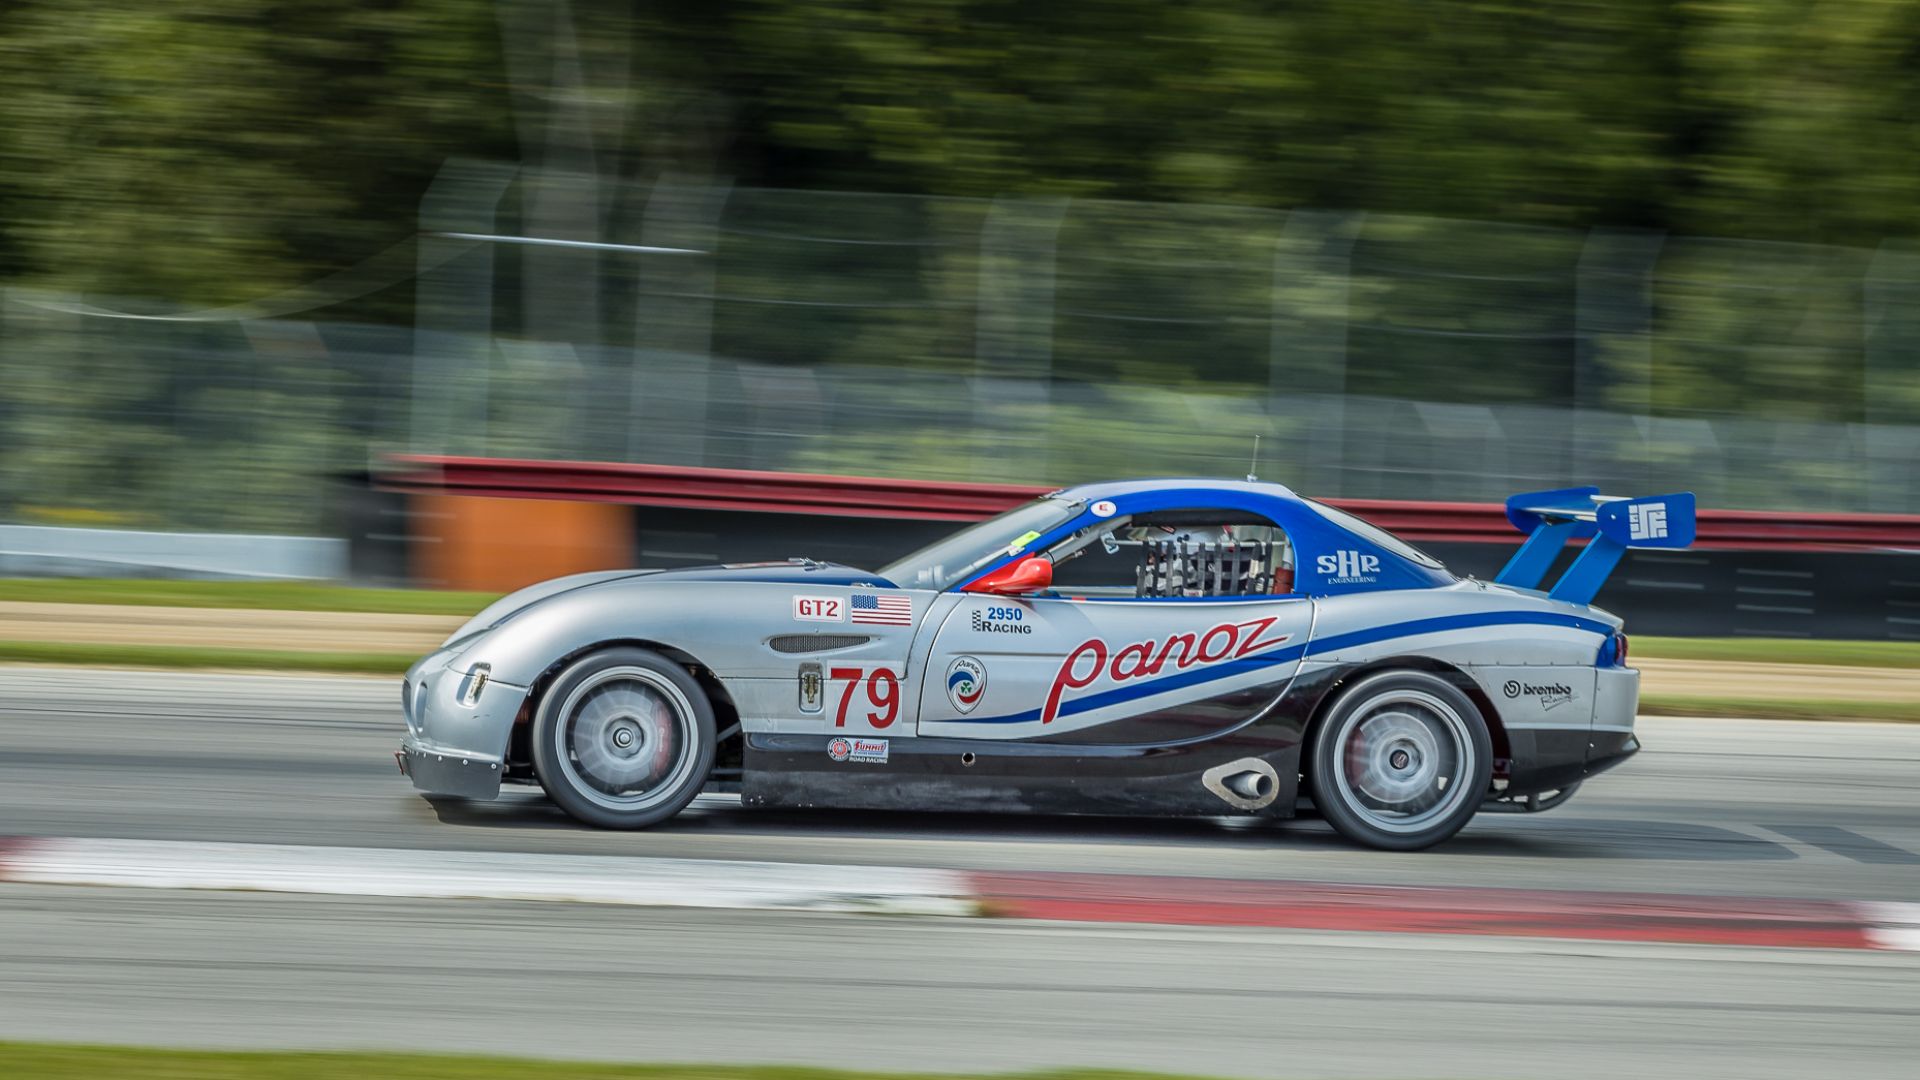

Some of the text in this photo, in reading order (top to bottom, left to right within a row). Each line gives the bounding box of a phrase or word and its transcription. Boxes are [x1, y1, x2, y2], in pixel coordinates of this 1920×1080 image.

[1316, 550, 1381, 578] SHR
[1327, 575, 1376, 585] ENGINEERING
[799, 600, 838, 617] GT2
[987, 607, 1023, 621] 2950
[1523, 682, 1572, 696] brembo
[831, 667, 900, 729] 79
